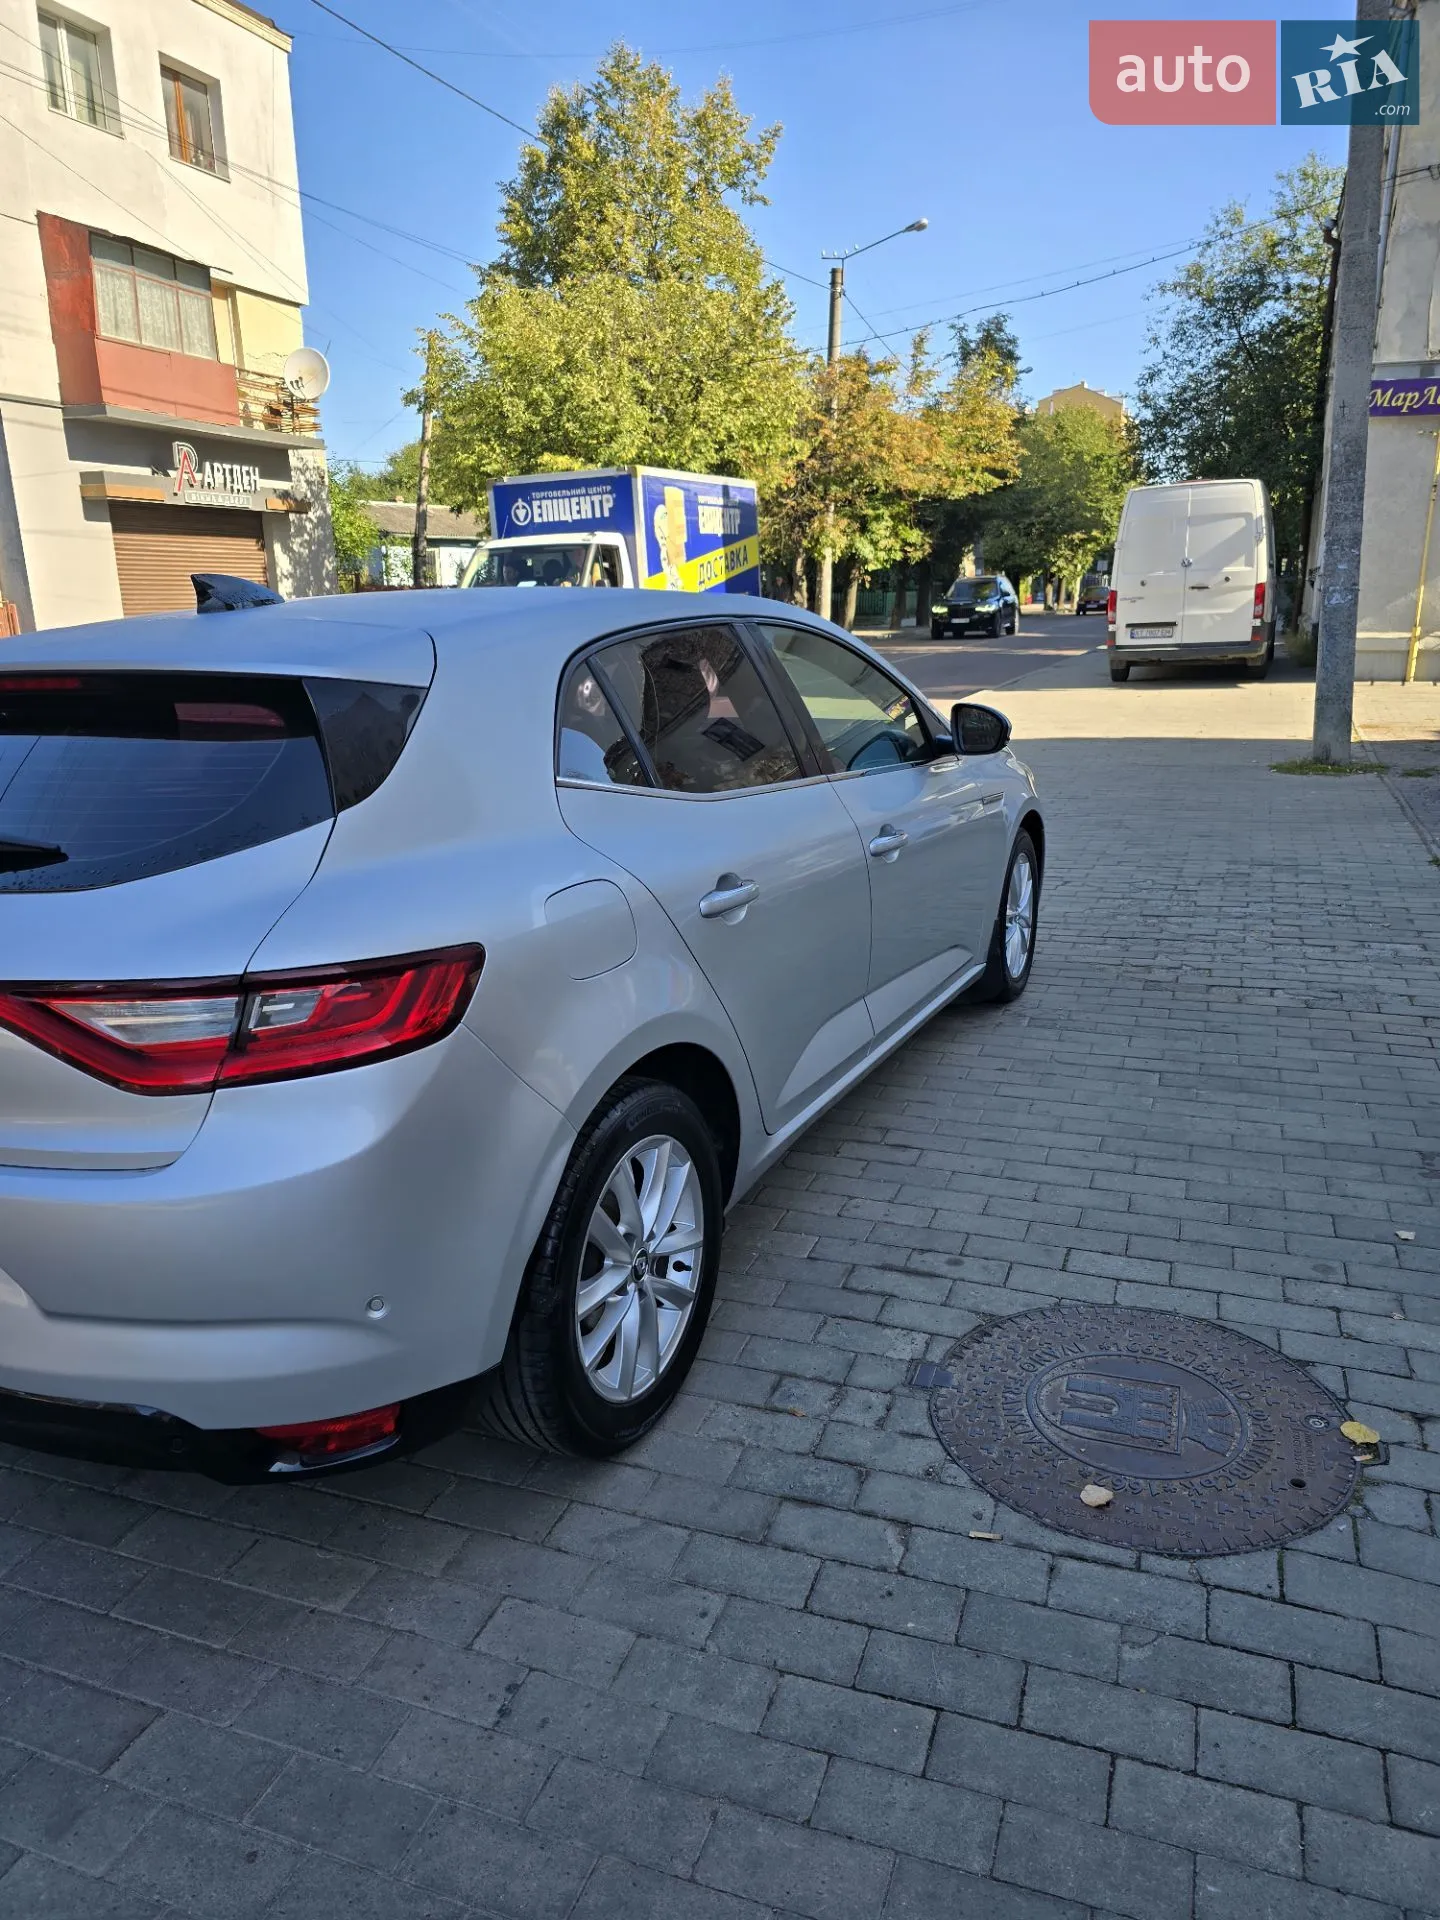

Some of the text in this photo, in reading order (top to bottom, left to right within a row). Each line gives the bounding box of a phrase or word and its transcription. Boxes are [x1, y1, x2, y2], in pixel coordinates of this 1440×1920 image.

[204, 461, 261, 493] АРТДЕН
[531, 485, 612, 500] ТОРГОВЕЛЬНИЙ ЦЕНТР
[532, 494, 614, 523] ЕПІЦЕНТР
[698, 544, 749, 588] ДОСТАВКА
